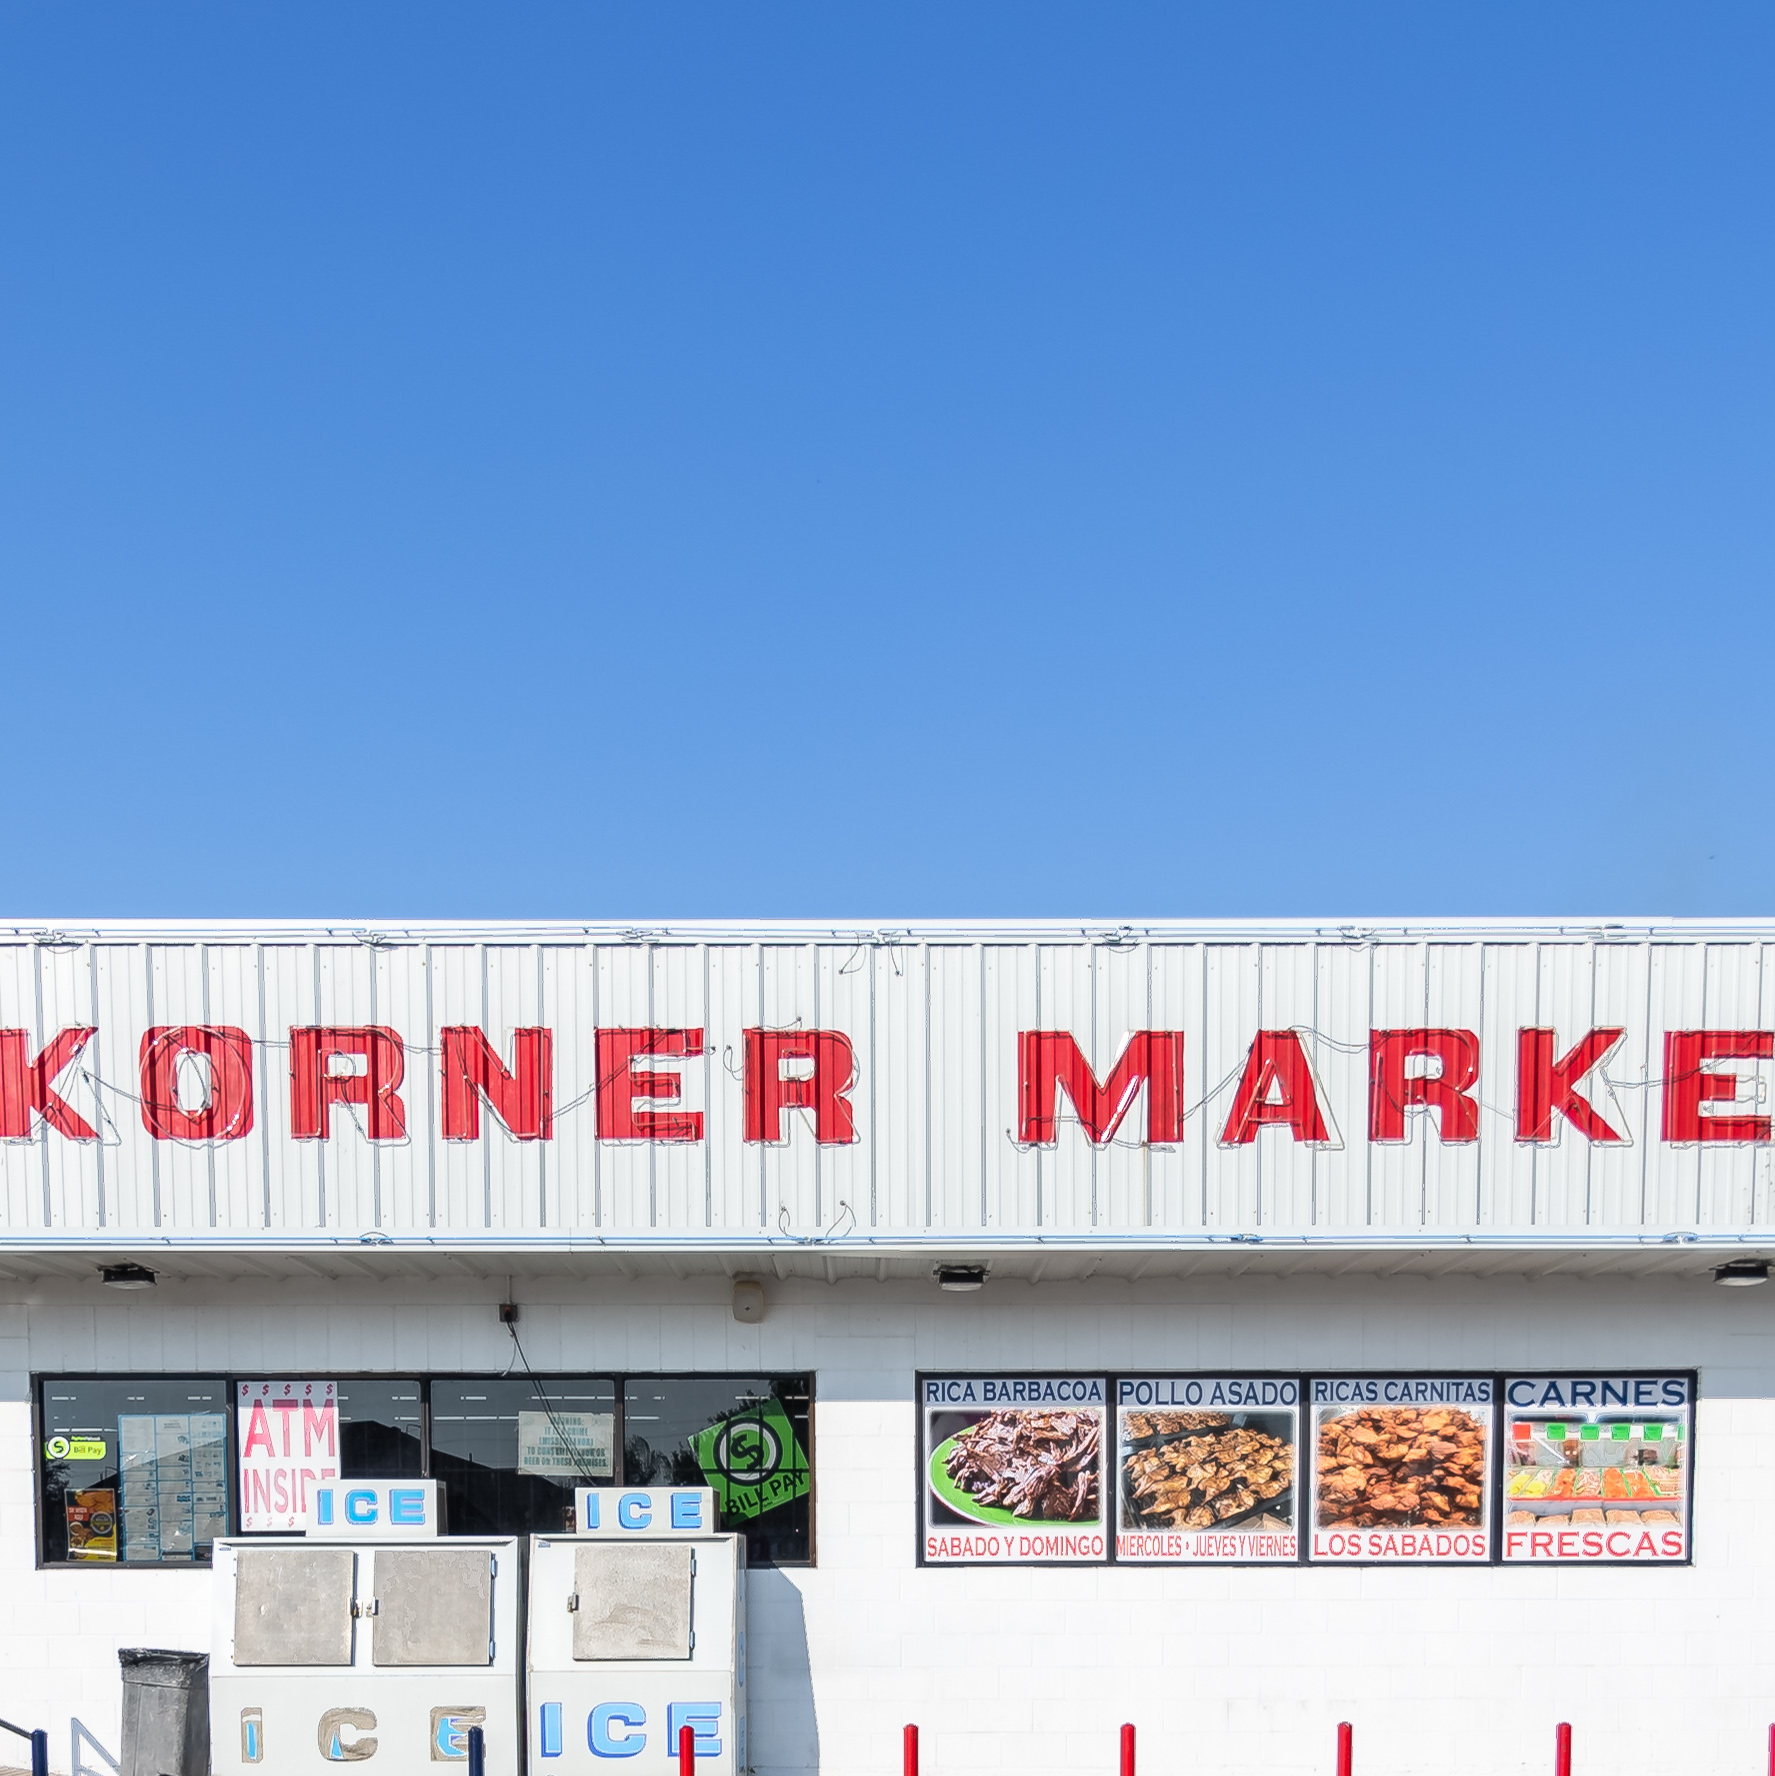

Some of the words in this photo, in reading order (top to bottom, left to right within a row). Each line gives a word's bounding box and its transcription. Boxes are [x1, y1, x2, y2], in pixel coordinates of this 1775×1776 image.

[926, 1381, 977, 1402] RICA
[983, 1381, 1102, 1401] BARBACOA
[1119, 1381, 1203, 1405] POLLO
[1209, 1381, 1297, 1405] ASADO
[1314, 1381, 1378, 1401] RICAS
[1384, 1381, 1491, 1401] CARNITAS
[1507, 1380, 1686, 1408] CARNES
[243, 1398, 336, 1458] ATM
[725, 1487, 770, 1516] BILL
[769, 1468, 805, 1497] PAY
[317, 1488, 426, 1526] ICE
[586, 1492, 703, 1530] ICE
[927, 1536, 1000, 1557] SABADO
[1004, 1536, 1015, 1557] Y
[1020, 1535, 1104, 1557] DOMINGO
[1115, 1535, 1182, 1557] MIERCOLES
[1192, 1535, 1237, 1557] JUEVES
[1239, 1535, 1247, 1557] Y
[1247, 1535, 1297, 1557] VIERNES
[1313, 1533, 1362, 1556] LOS
[1368, 1533, 1486, 1556] SABADOS
[1506, 1531, 1683, 1557] FRESCAS
[240, 1706, 487, 1764] ICE
[540, 1701, 723, 1759] ICE
